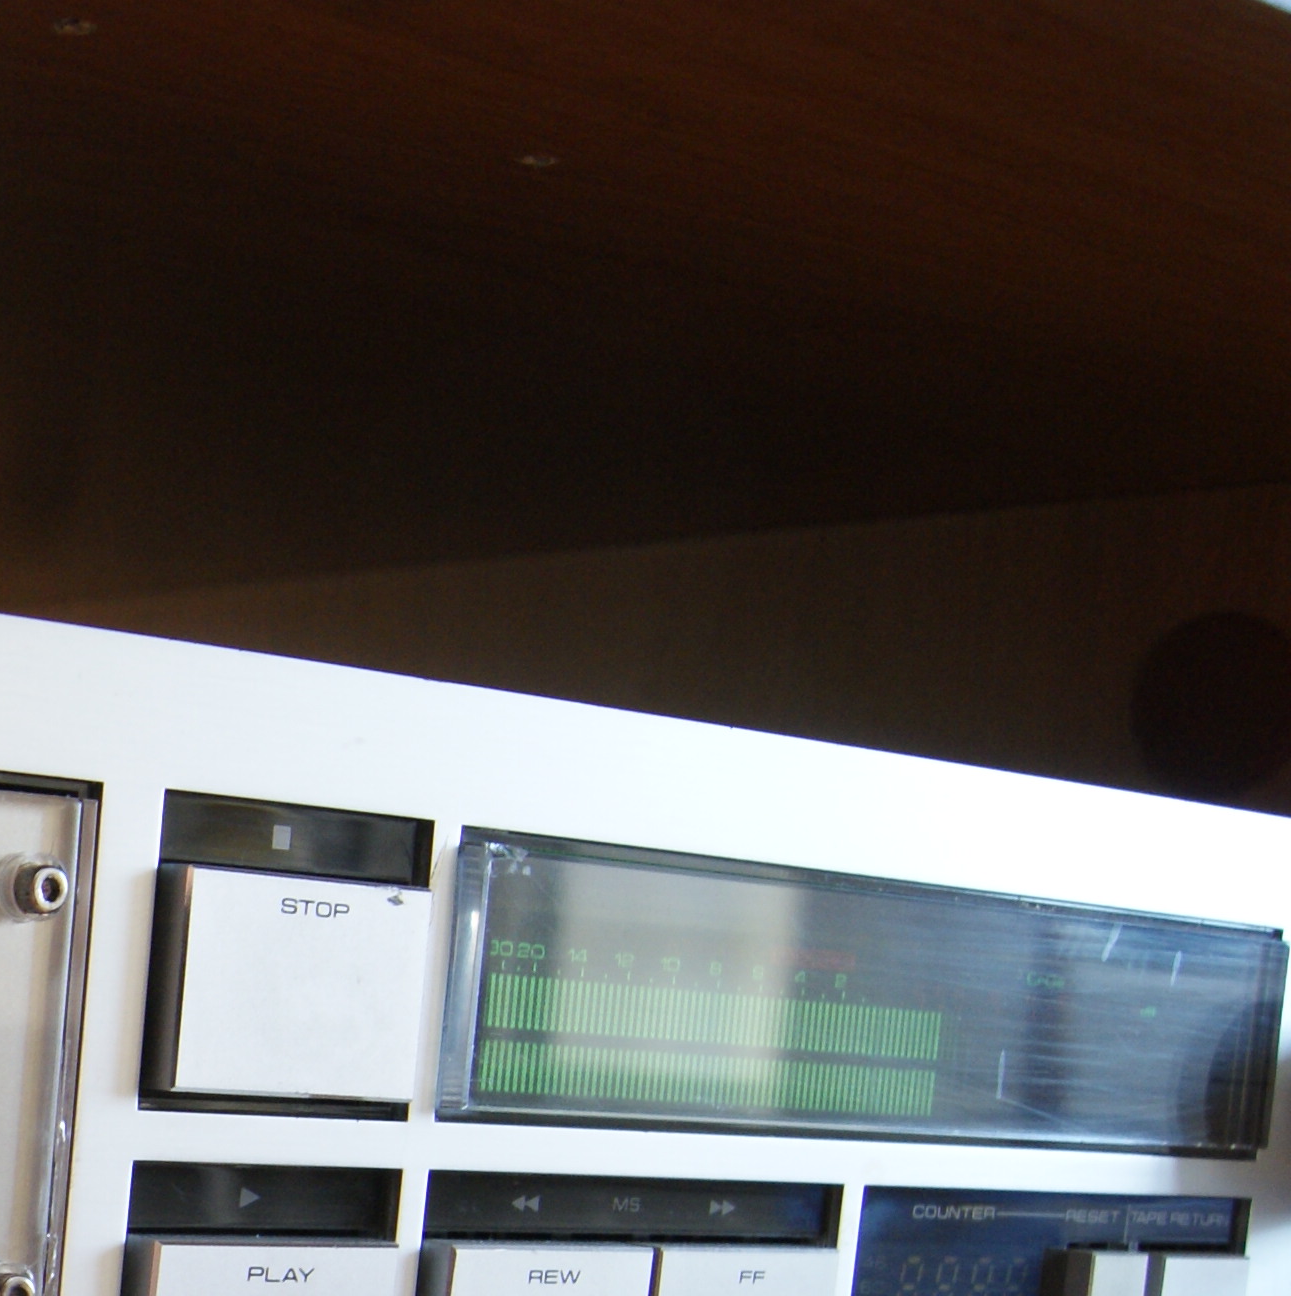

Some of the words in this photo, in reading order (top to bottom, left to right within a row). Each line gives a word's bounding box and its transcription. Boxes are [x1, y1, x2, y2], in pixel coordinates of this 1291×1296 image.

[280, 898, 350, 918] STOP
[613, 1197, 640, 1213] MS
[912, 1204, 996, 1220] COUNTER
[1065, 1208, 1120, 1223] RESET
[1130, 1210, 1168, 1225] TAPE
[246, 1266, 315, 1283] PLAY
[527, 1269, 581, 1285] REW
[739, 1270, 766, 1284] FF
